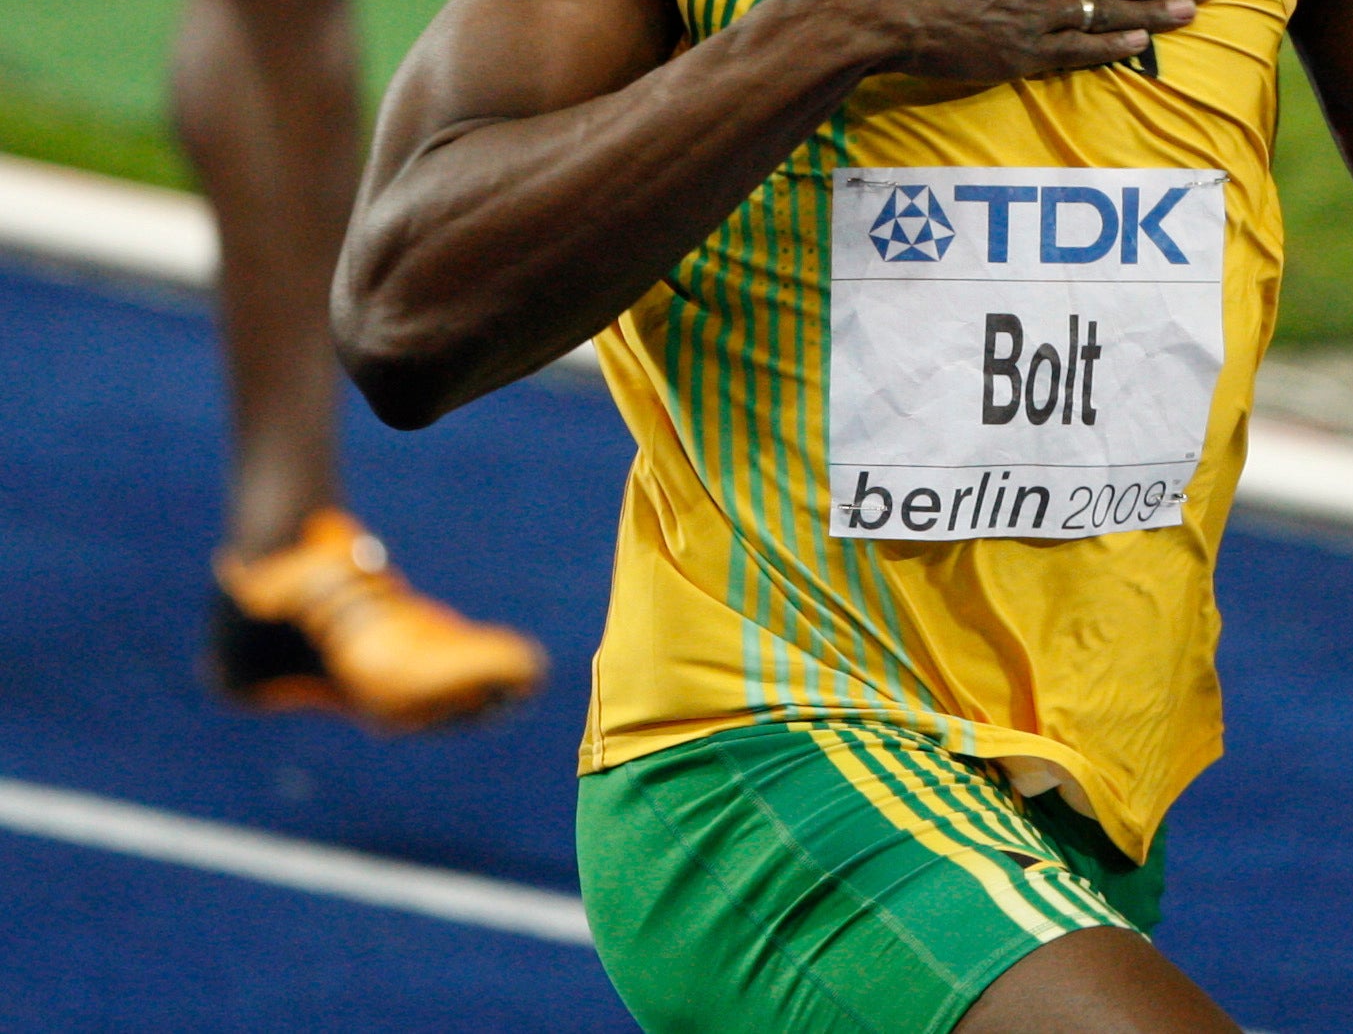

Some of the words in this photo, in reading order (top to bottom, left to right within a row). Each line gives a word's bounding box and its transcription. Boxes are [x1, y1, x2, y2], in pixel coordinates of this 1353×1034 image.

[953, 184, 1191, 265] TDK
[981, 312, 1102, 426] Bolt
[848, 471, 1051, 531] berlin
[1061, 480, 1167, 531] 2009
